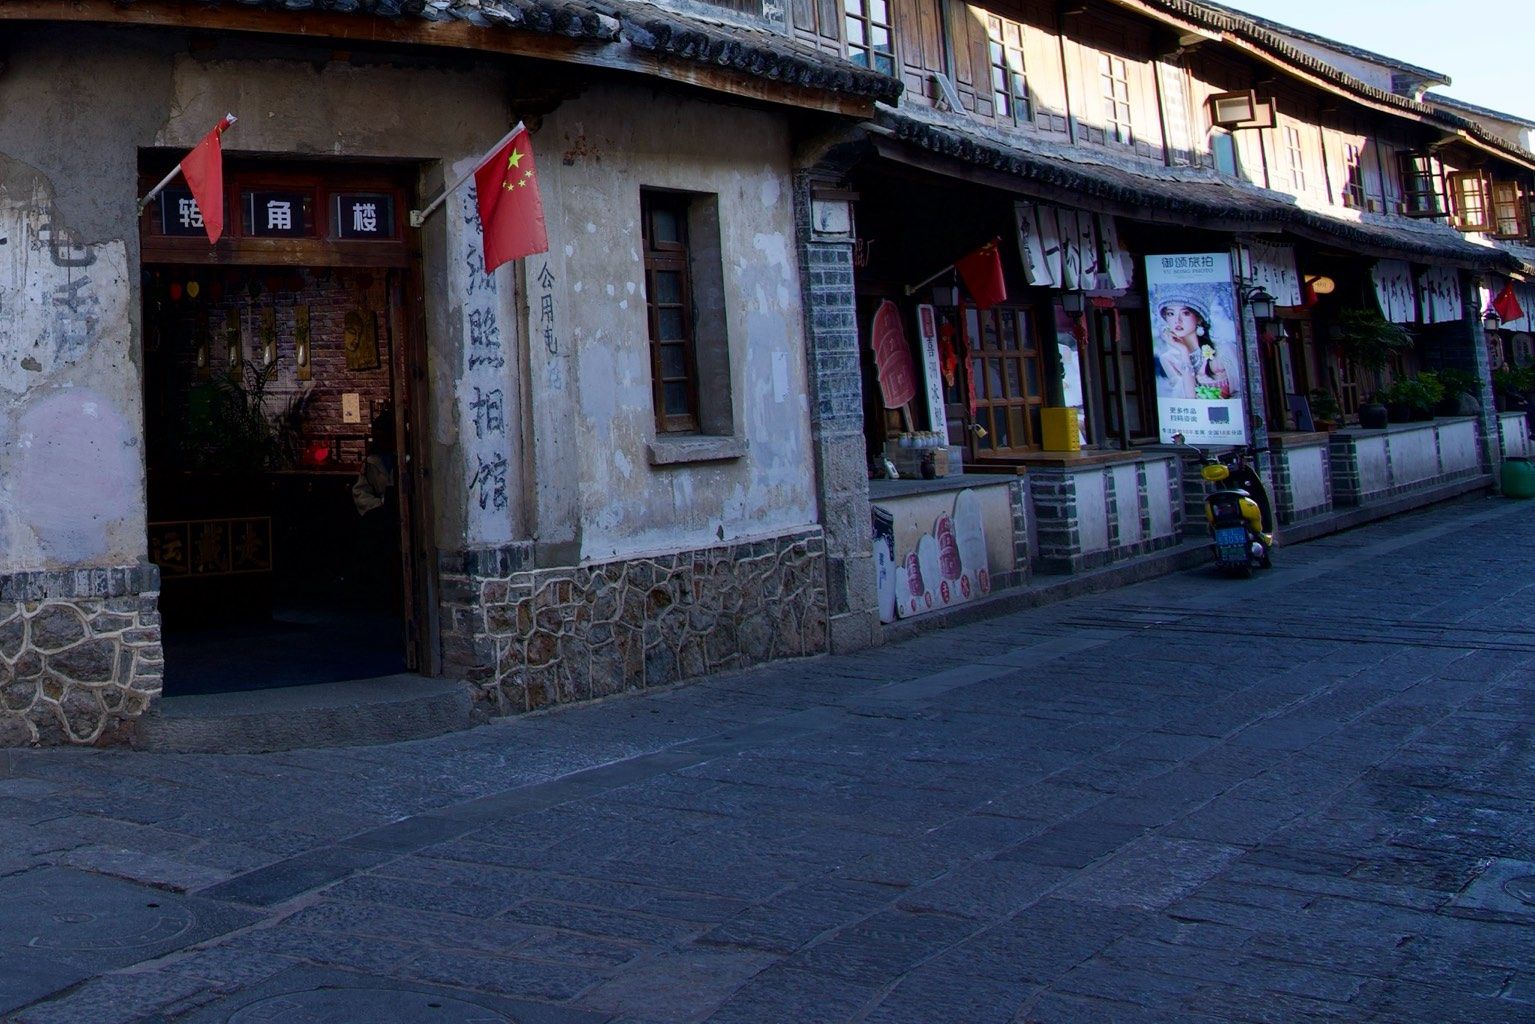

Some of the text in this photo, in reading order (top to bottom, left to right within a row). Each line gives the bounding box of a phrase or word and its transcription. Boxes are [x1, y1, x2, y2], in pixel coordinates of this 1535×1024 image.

[179, 198, 377, 232] 转角楼
[1162, 256, 1214, 268] 御颂旅拍
